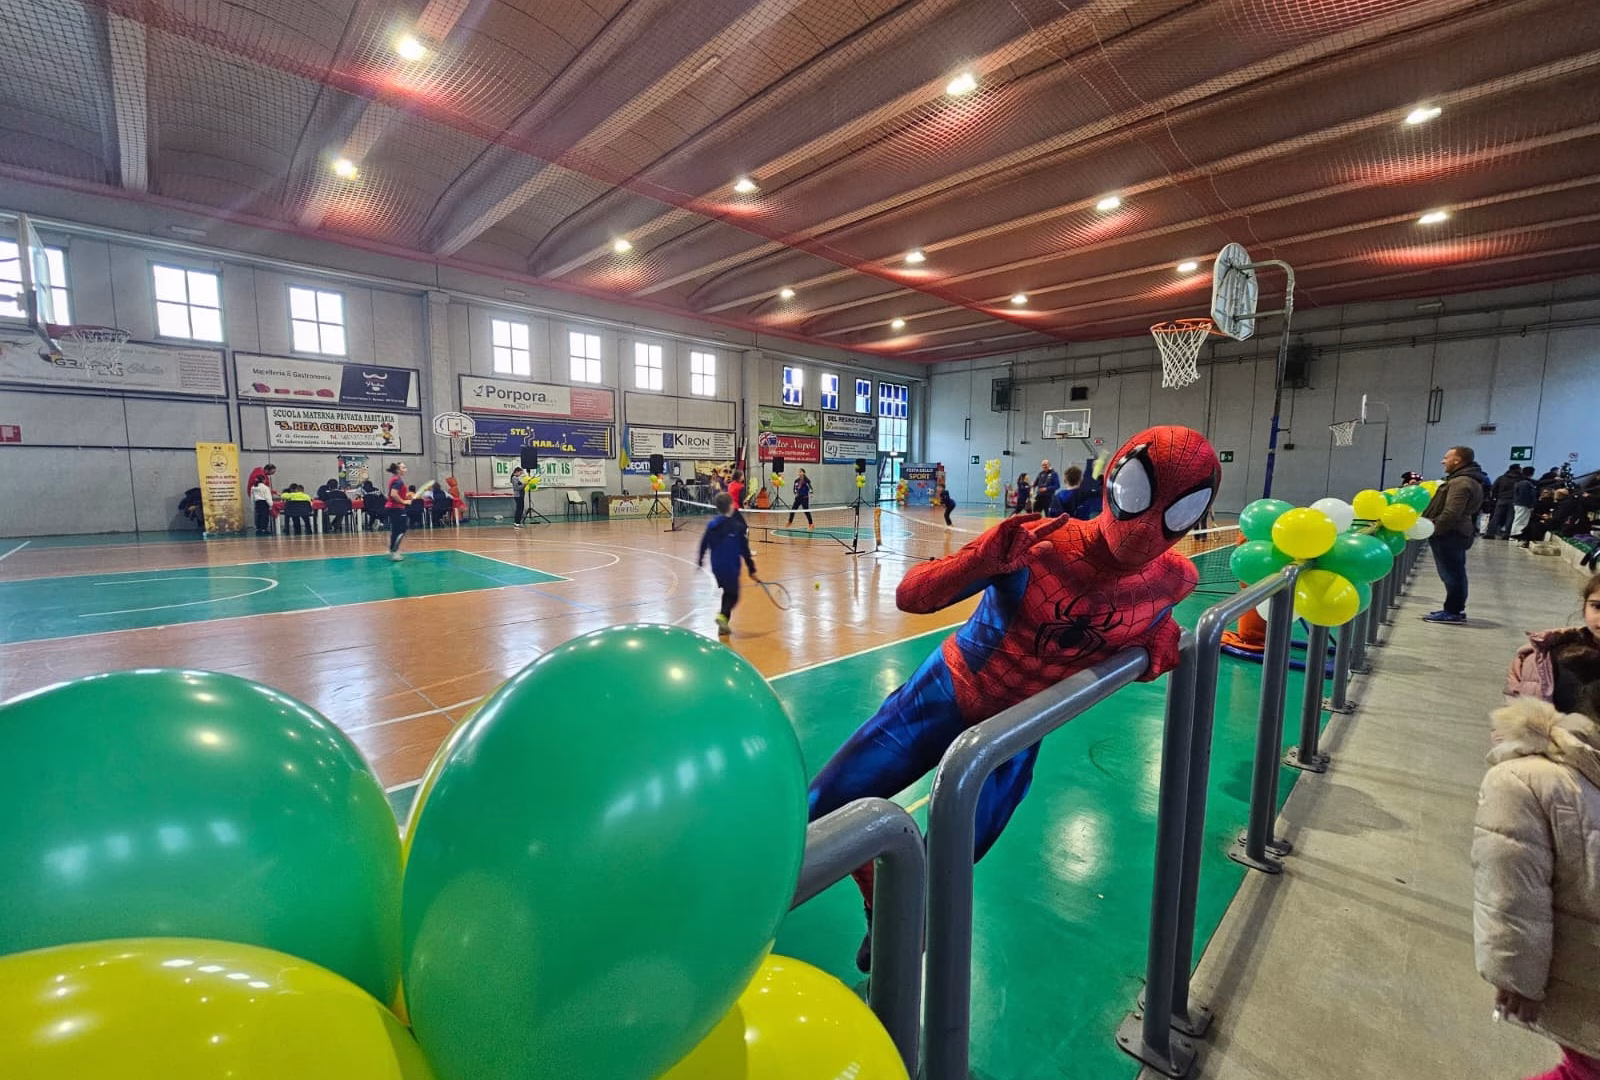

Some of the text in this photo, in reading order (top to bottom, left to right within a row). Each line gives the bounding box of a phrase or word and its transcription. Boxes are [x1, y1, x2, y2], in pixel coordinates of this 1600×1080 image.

[485, 385, 546, 403] Porpora
[273, 409, 301, 419] SCUOLA
[302, 410, 335, 420] MATERNA
[336, 412, 363, 422] PRIVATA
[293, 422, 319, 432] RITA
[320, 423, 347, 433] CLUB
[496, 461, 508, 474] DE
[613, 505, 640, 514] VIRTUS
